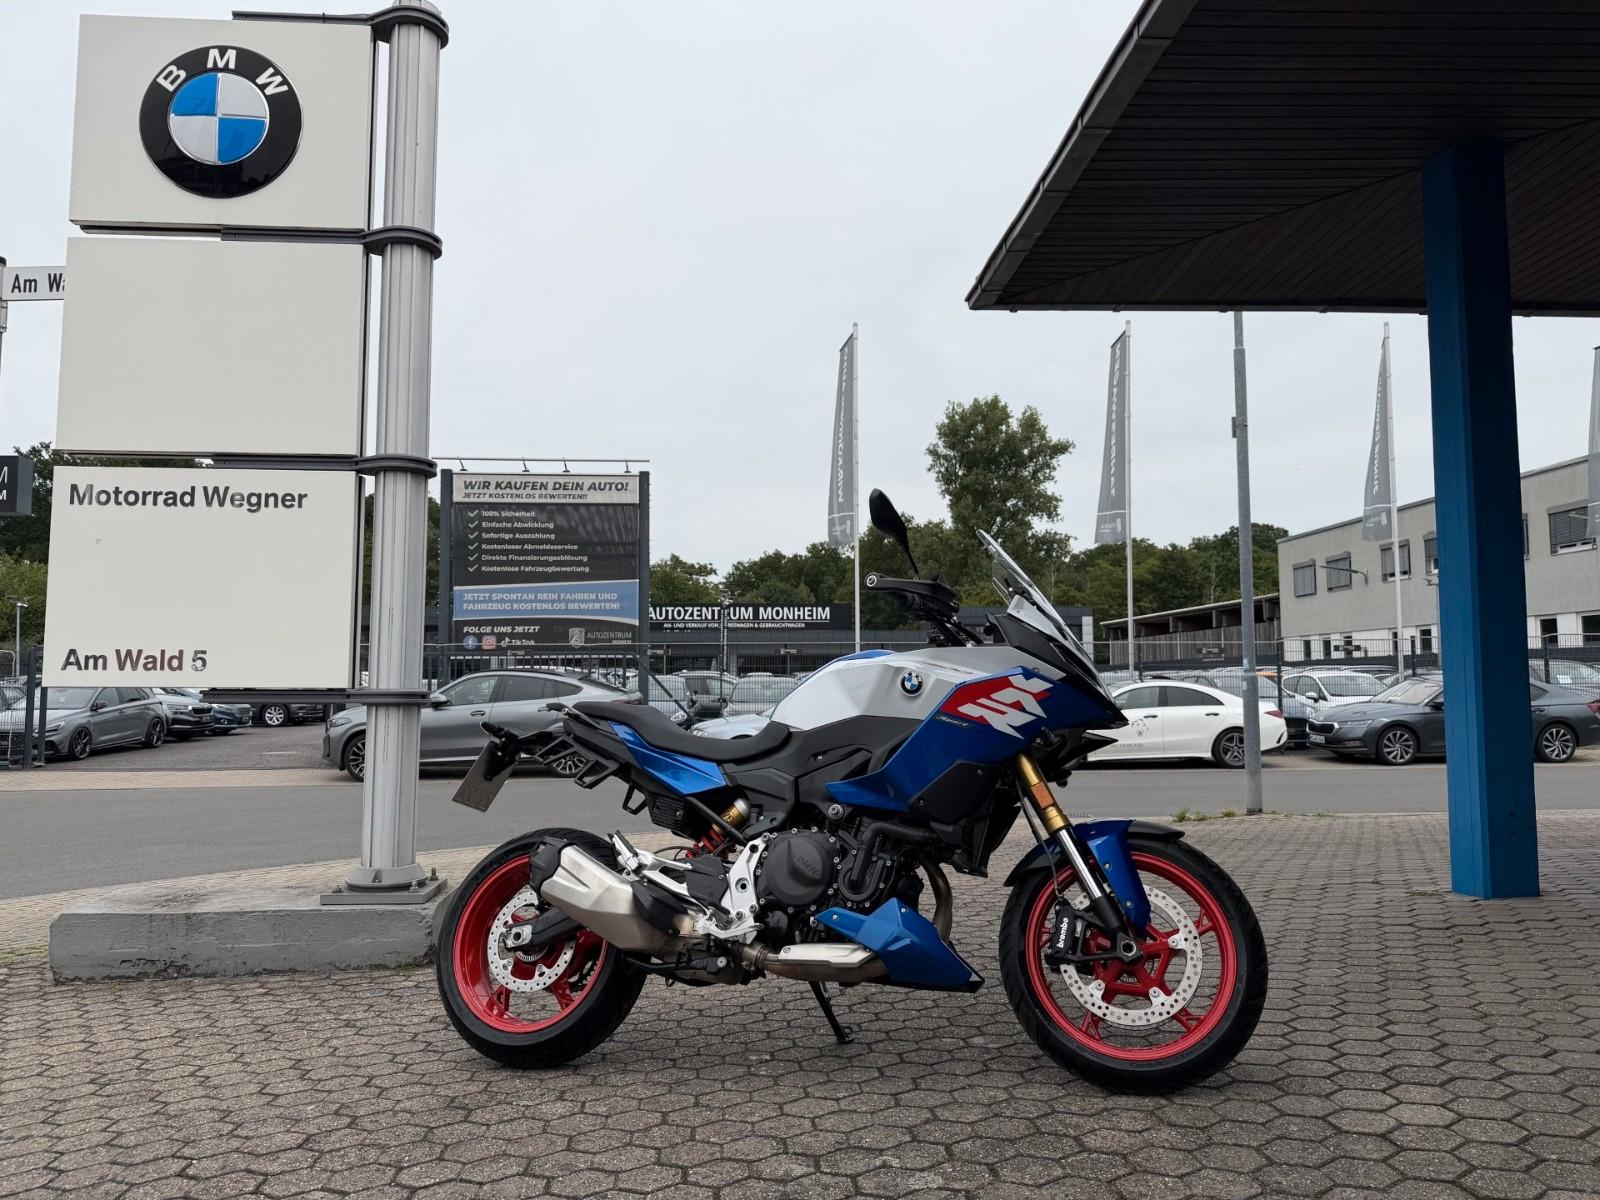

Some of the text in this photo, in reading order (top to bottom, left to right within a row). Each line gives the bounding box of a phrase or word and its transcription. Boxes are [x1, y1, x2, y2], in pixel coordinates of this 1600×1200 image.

[156, 48, 289, 95] BMW
[11, 272, 65, 293] Am W
[463, 480, 629, 491] WIR KAUFEN DEIN AUTO!
[69, 483, 308, 513] Motorrad Wegner
[513, 521, 554, 529] Abwicklung
[482, 532, 555, 540] Sofortige Auszahlung
[520, 565, 589, 573] Fahrzeugbewertung
[561, 592, 596, 600] FAHREN
[598, 592, 618, 600] UND
[648, 606, 830, 620] AUTOZENTUM MONHEIM
[587, 631, 632, 639] AUTOZENTRUM
[60, 648, 207, 672] Am Wald 5
[1056, 917, 1069, 948] brembo
